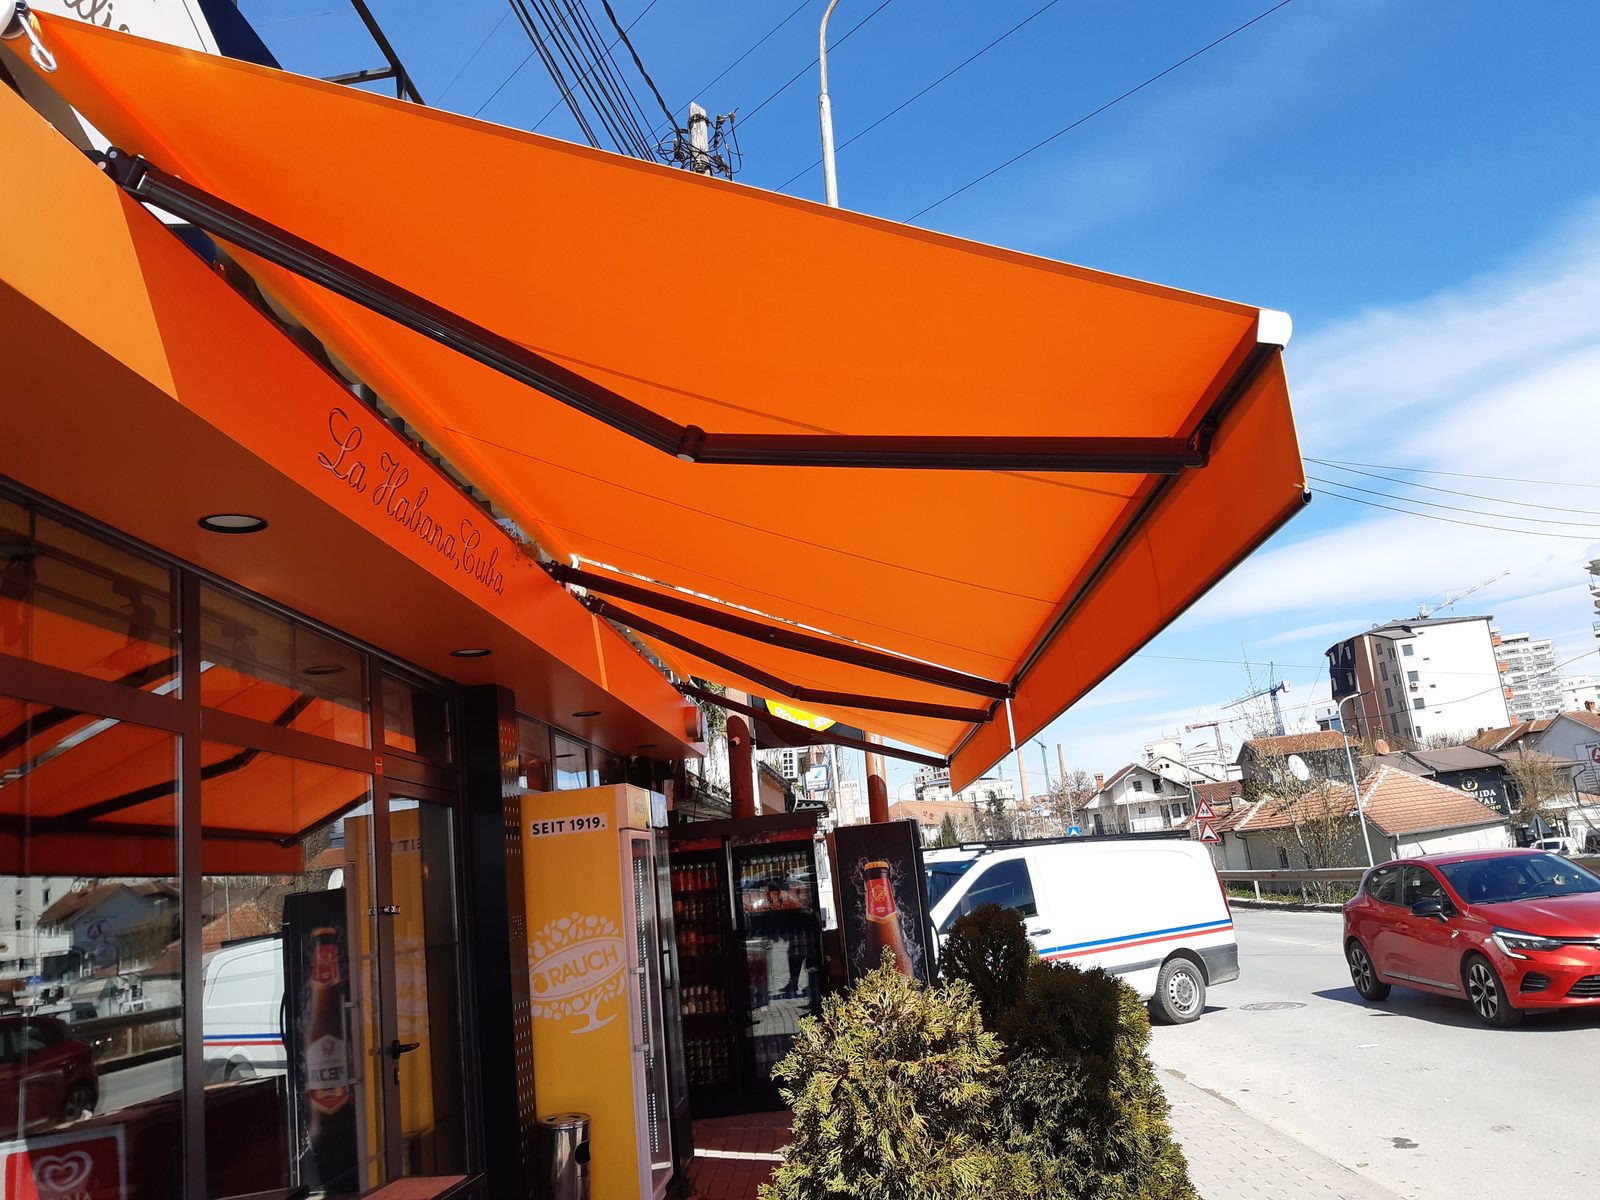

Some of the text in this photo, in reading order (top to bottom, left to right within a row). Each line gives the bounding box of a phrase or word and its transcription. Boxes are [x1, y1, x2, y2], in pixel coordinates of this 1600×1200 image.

[317, 407, 505, 596] La Habana, Cuba
[1470, 789, 1496, 798] MIDA
[1478, 797, 1496, 805] YAL
[532, 816, 606, 835] SEIT 1919.
[548, 944, 619, 987] RAUCH
